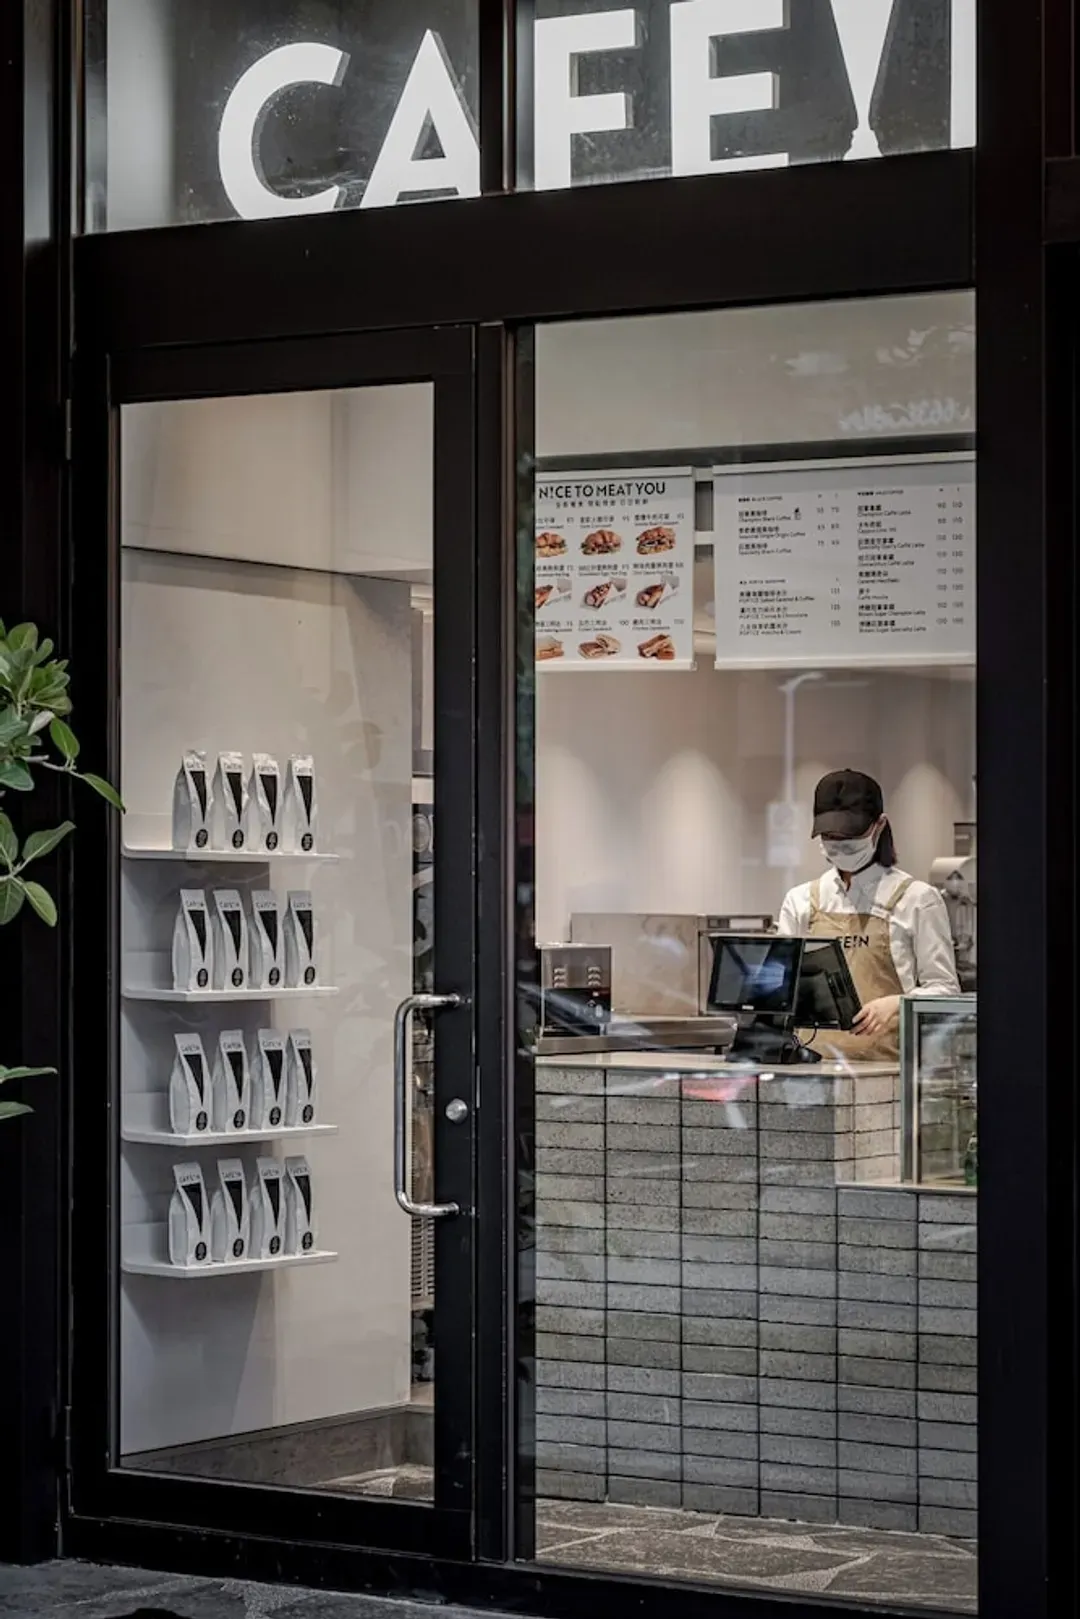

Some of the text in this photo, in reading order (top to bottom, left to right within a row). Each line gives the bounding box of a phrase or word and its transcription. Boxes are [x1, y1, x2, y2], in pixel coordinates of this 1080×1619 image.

[574, 484, 594, 498] TO
[596, 483, 633, 497] MEAT
[635, 481, 666, 495] YOU
